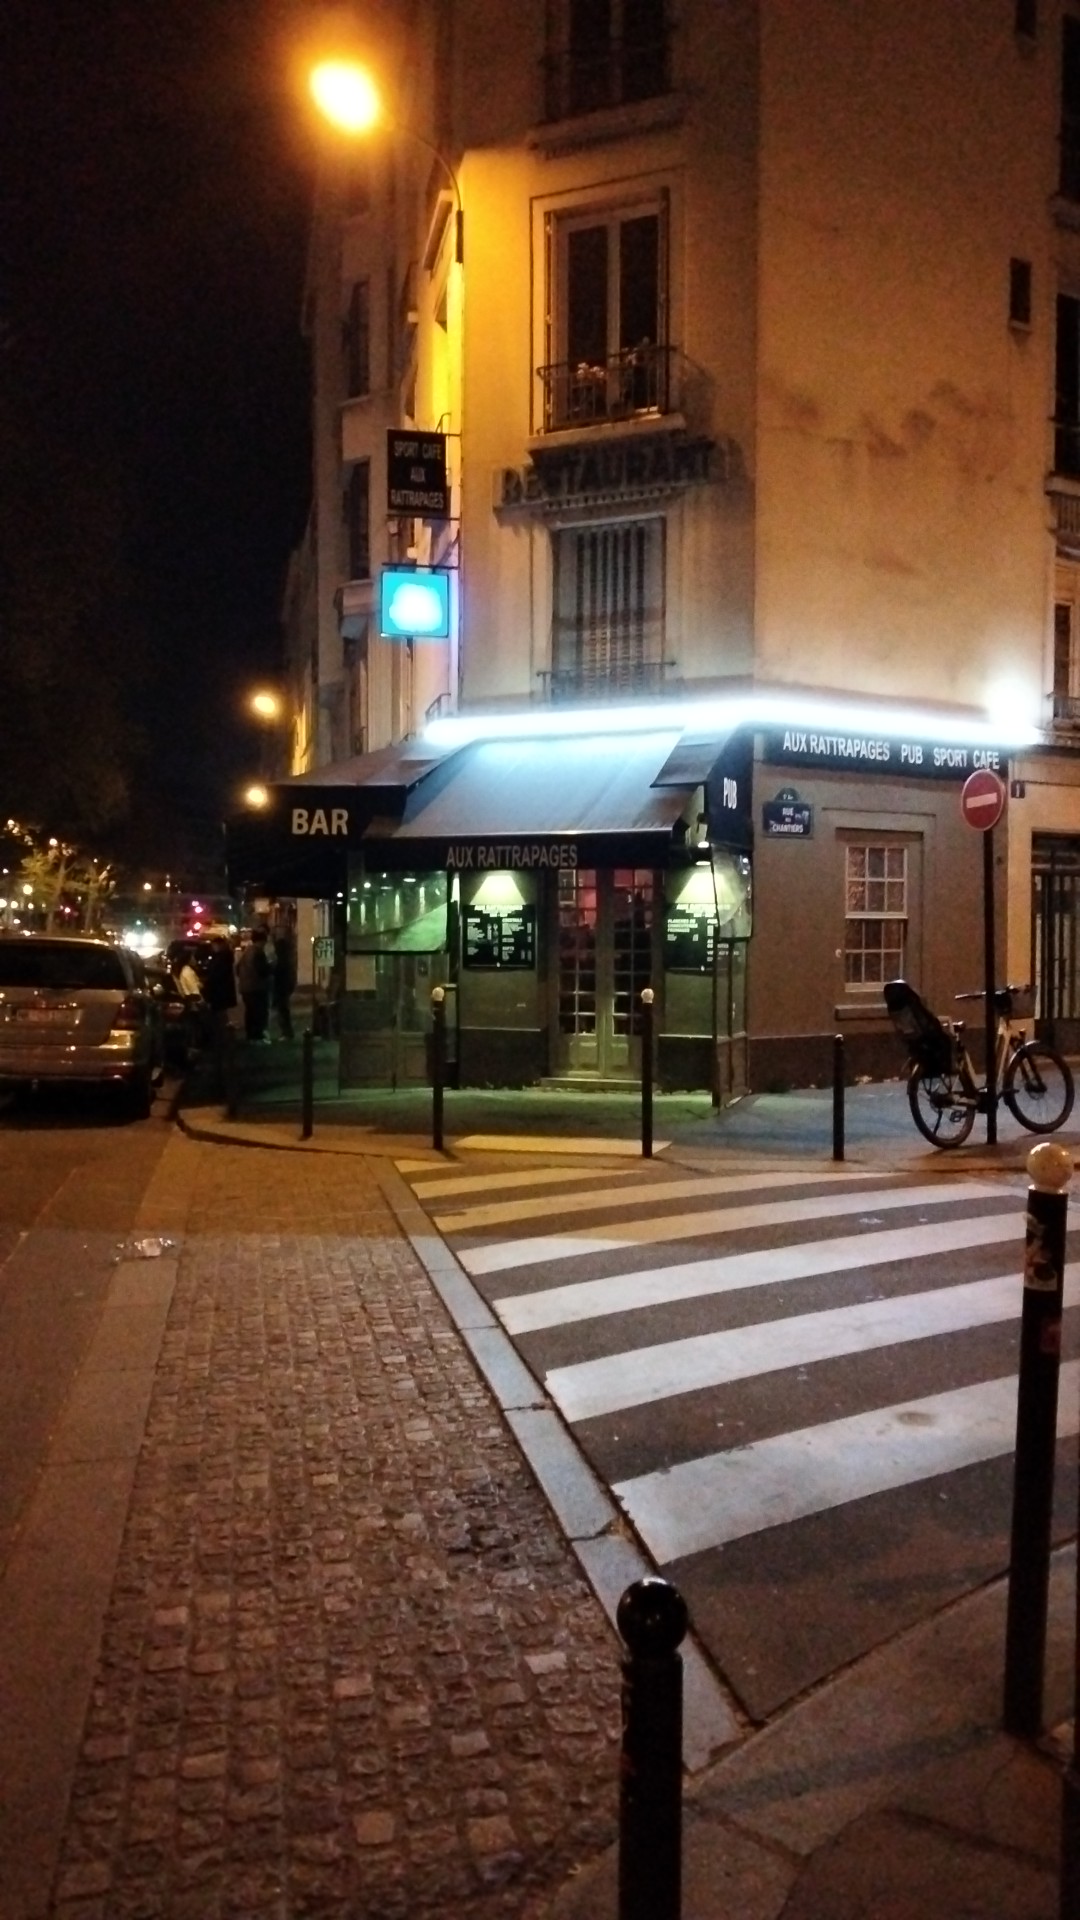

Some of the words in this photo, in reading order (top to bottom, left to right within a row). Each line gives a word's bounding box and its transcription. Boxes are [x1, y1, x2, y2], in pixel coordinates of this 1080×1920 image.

[394, 441, 419, 458] SPORT
[391, 489, 444, 509] RATTRAPAGES
[783, 730, 807, 753] AUX
[810, 734, 891, 761] RATTRAPAGES
[901, 743, 924, 764] PUB
[933, 747, 968, 768] SPORT
[973, 749, 1000, 770] CAFE
[723, 777, 738, 809] PUB
[292, 808, 349, 835] BAR
[782, 807, 794, 816] RUE
[772, 823, 804, 833] CHANTIERS
[446, 846, 474, 868] AUX
[477, 844, 578, 868] RATTRAPAGES
